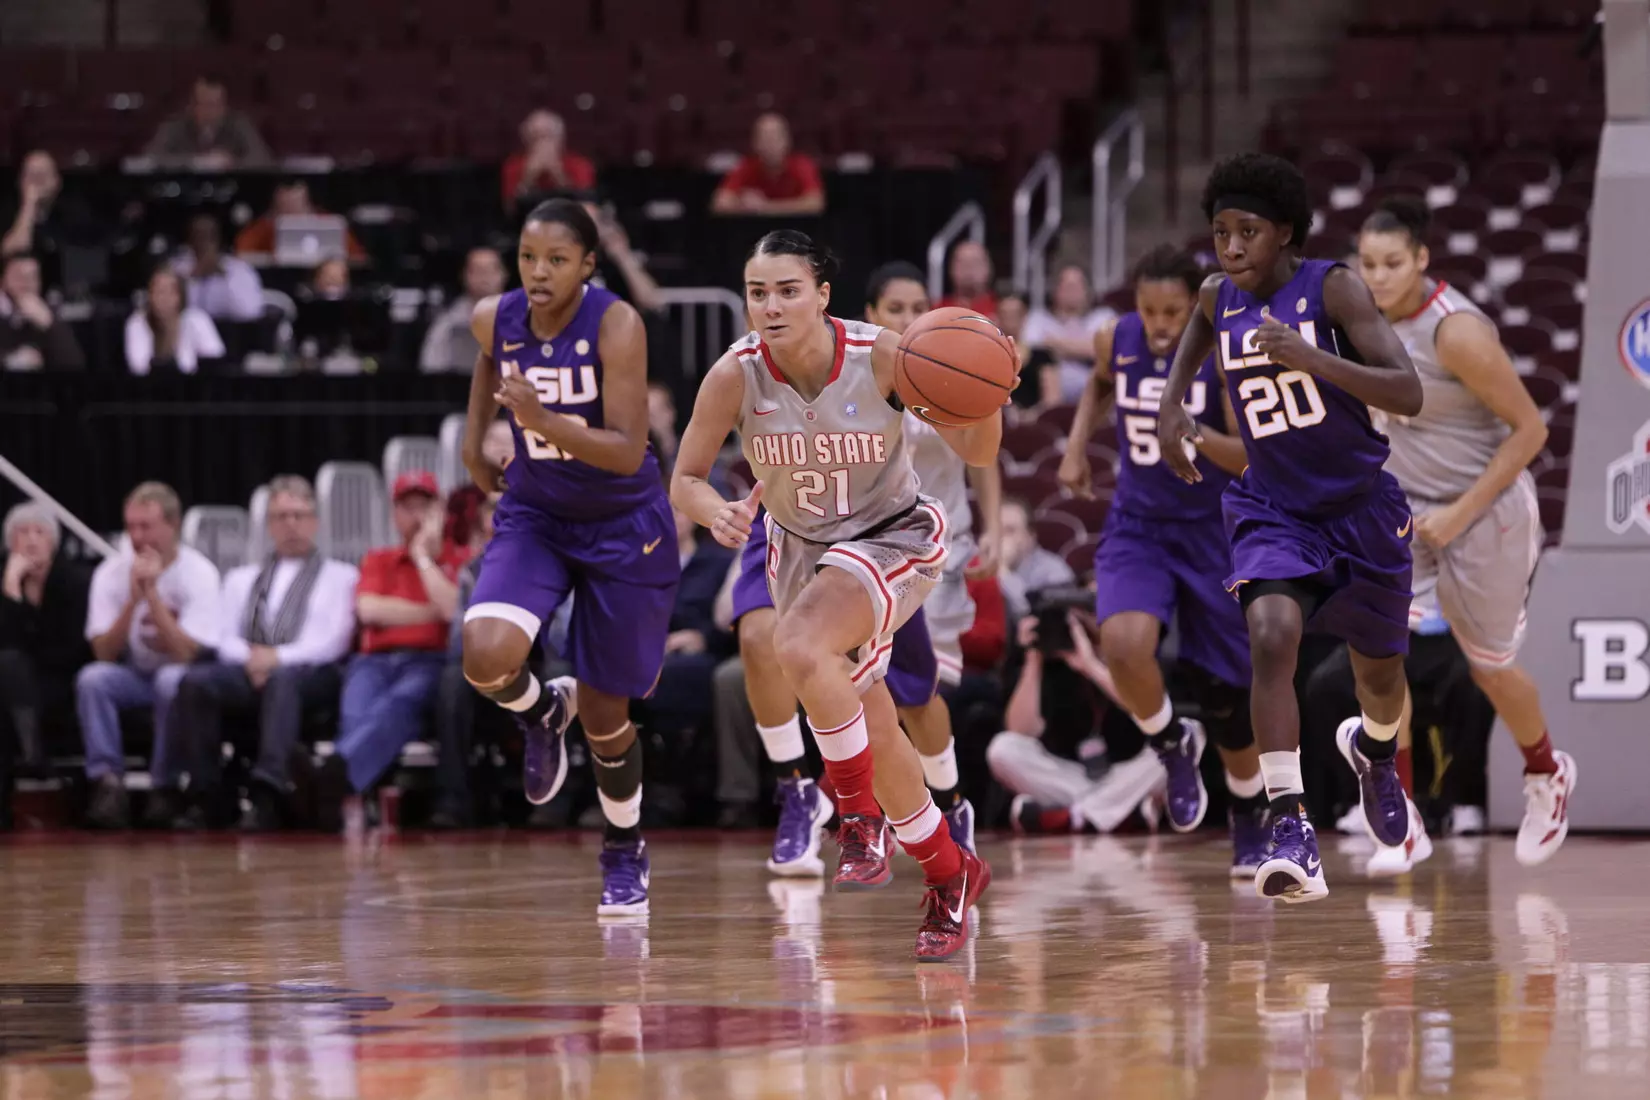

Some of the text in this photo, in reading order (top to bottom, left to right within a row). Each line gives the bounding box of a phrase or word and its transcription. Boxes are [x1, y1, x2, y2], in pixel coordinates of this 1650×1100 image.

[1238, 370, 1327, 439] 20
[752, 432, 886, 466] OHIO STATE
[791, 468, 850, 517] 21
